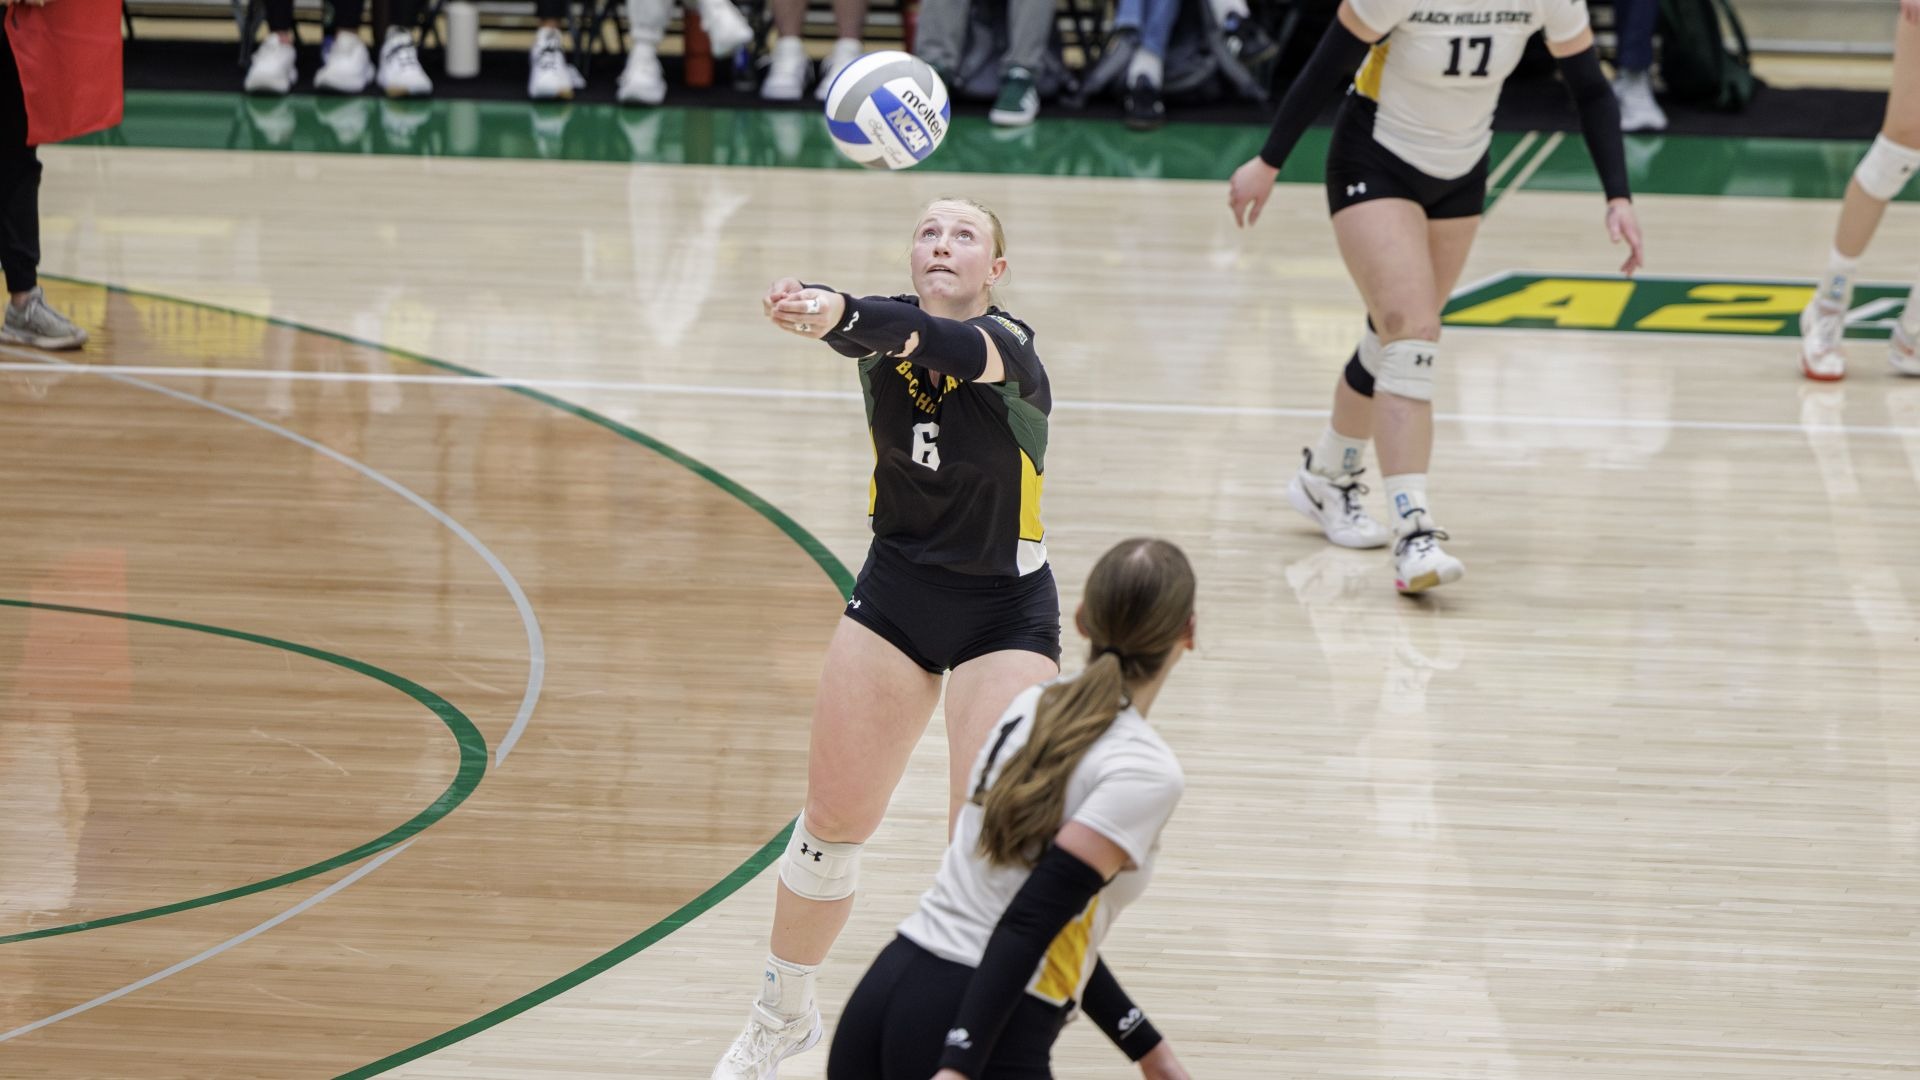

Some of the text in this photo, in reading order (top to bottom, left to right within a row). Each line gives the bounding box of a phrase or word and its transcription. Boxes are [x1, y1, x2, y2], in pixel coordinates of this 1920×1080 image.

[1408, 10, 1531, 24] BLACK HILLS STATE
[1443, 36, 1493, 77] 17
[886, 106, 930, 154] NCAA
[902, 90, 943, 141] molten
[912, 421, 941, 471] 6
